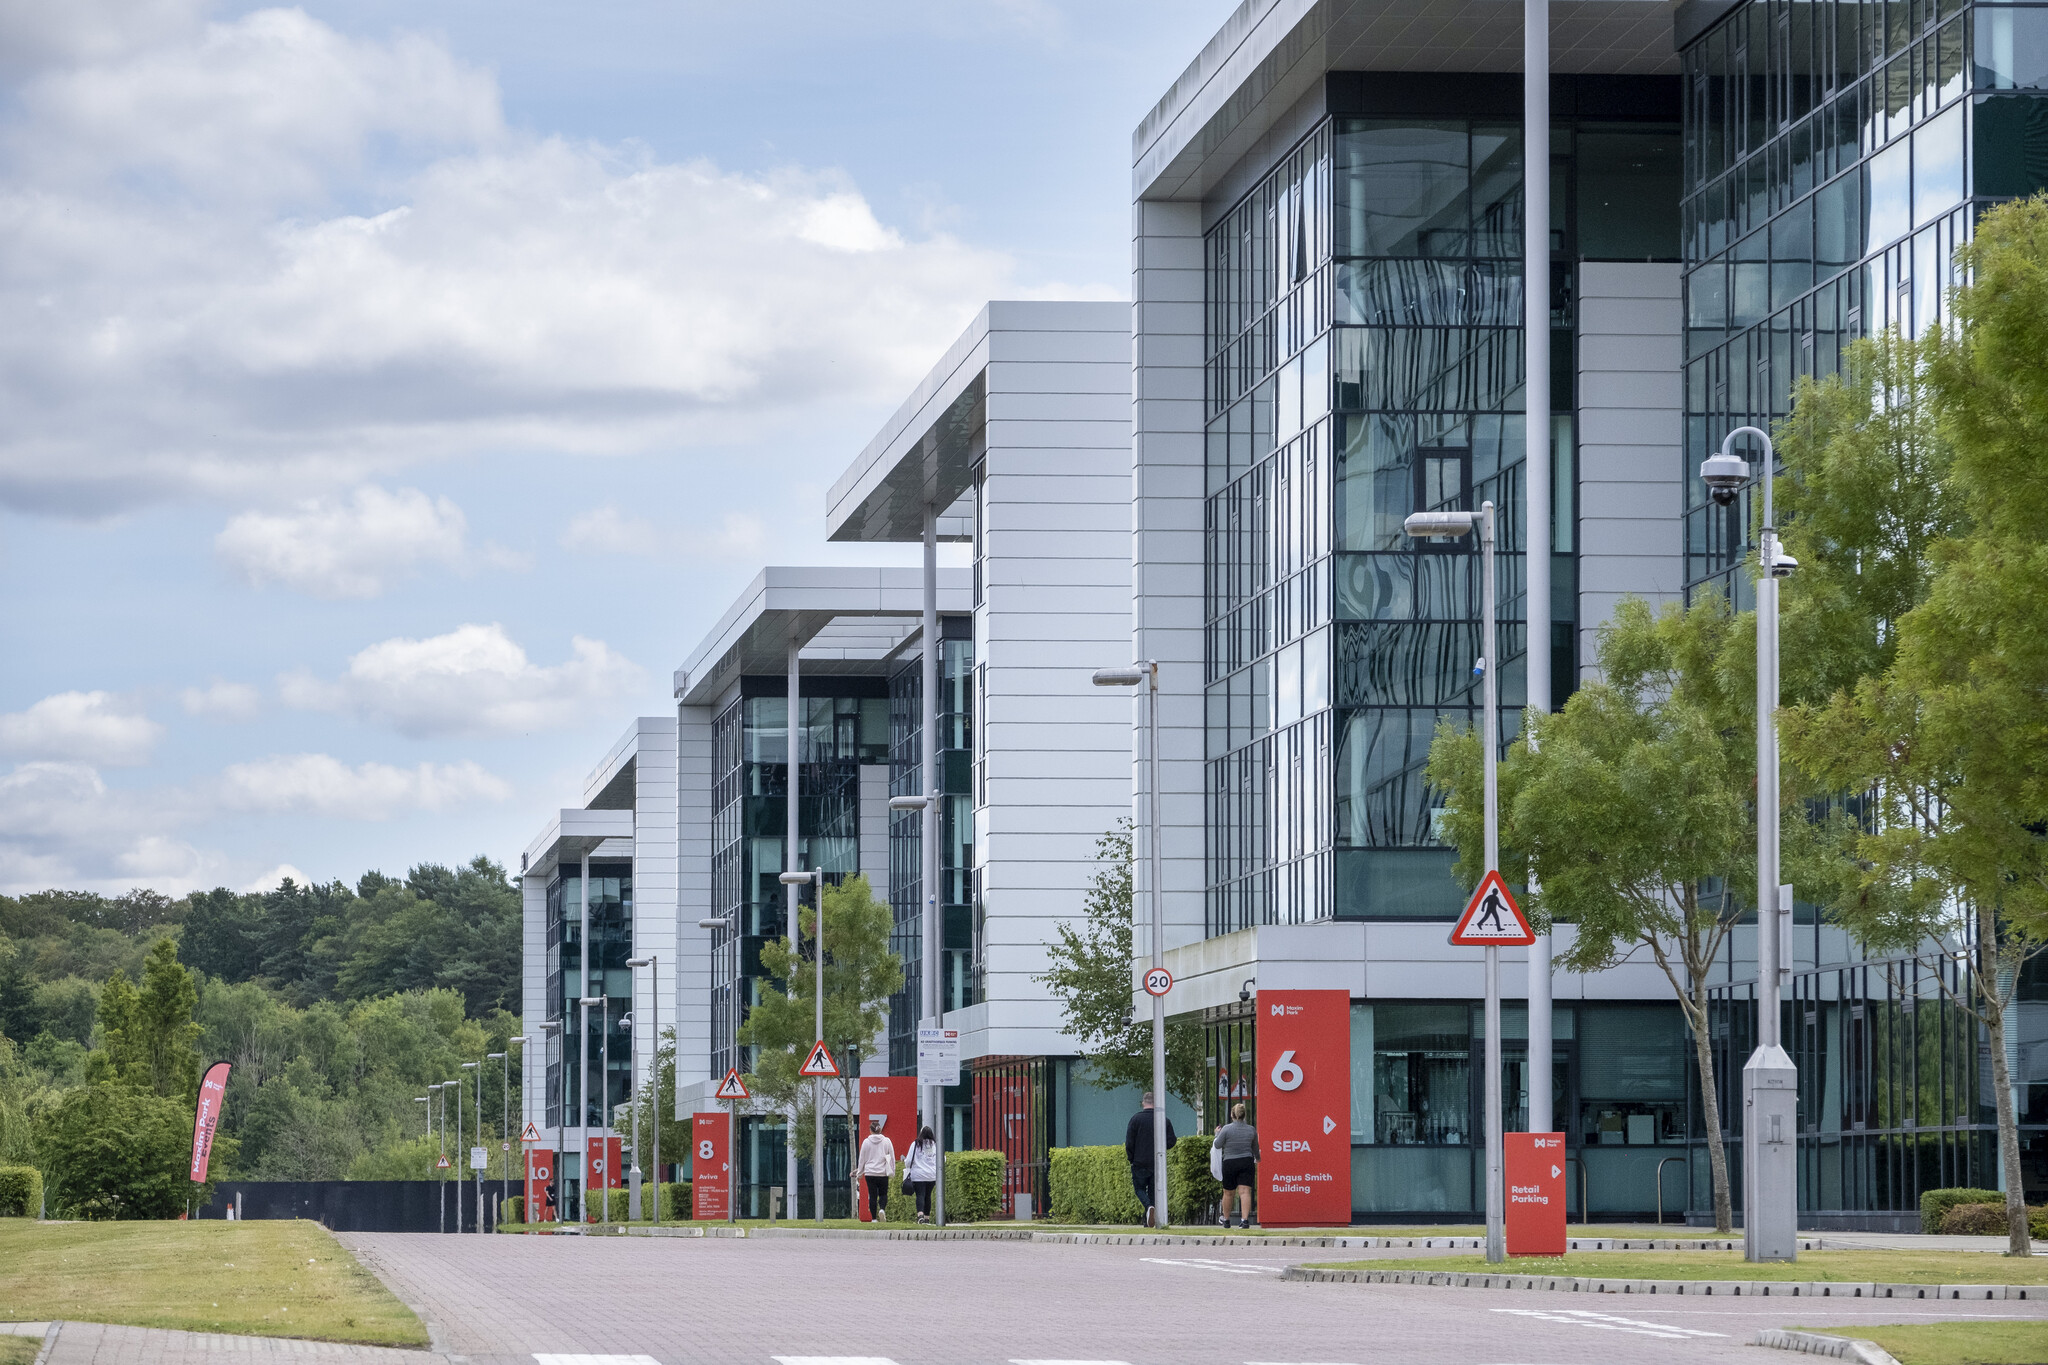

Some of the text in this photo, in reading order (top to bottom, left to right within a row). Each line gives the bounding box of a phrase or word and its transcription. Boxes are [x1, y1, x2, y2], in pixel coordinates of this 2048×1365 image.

[1150, 976, 1168, 988] 20
[1271, 1050, 1304, 1091] 6
[868, 1114, 888, 1133] 7
[193, 1097, 211, 1172] Maxim Park
[202, 1116, 216, 1158] Events
[699, 1140, 714, 1160] 8
[1272, 1140, 1312, 1153] SEPA
[593, 1159, 603, 1174] 9
[1272, 1173, 1333, 1183] Angus Smith
[1272, 1184, 1311, 1194] Building
[1512, 1185, 1540, 1193] Retail
[1512, 1194, 1548, 1205] Parking
